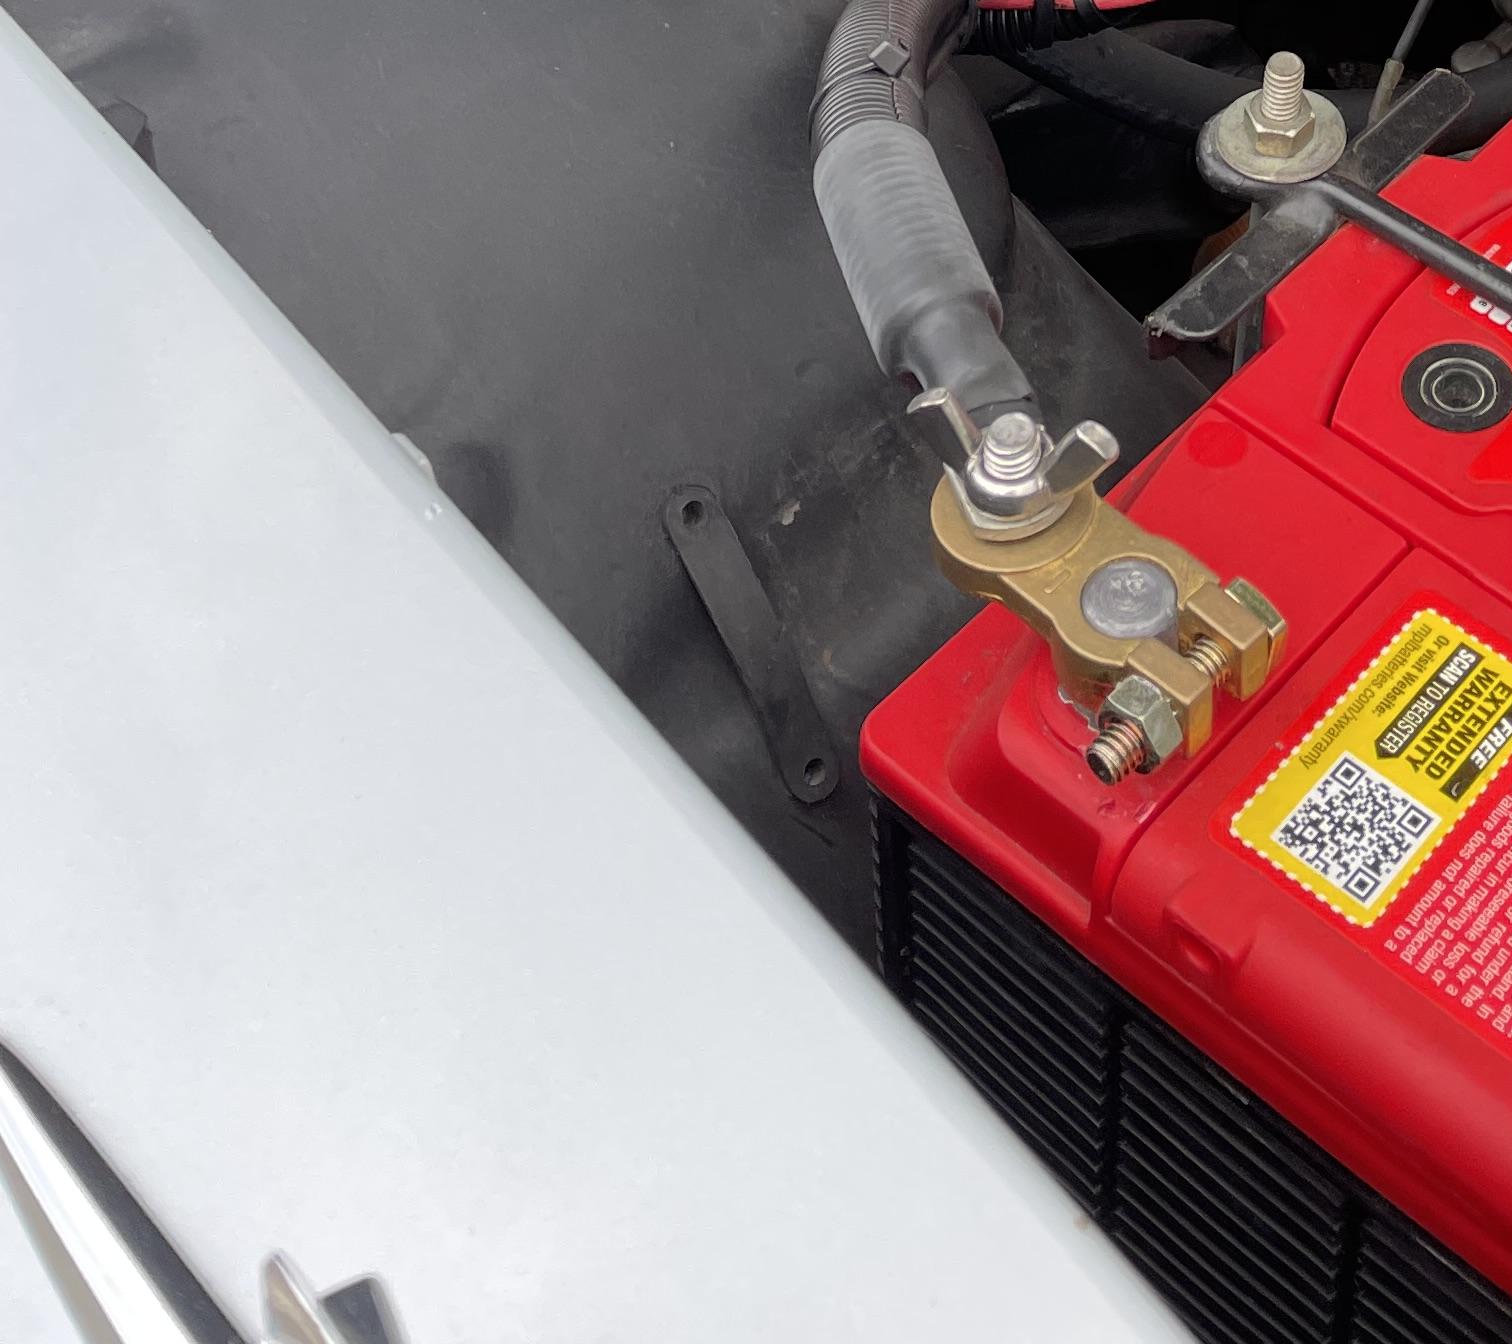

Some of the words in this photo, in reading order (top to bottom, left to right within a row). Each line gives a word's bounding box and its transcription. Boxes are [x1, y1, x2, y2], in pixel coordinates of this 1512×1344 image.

[1411, 646, 1438, 673] visit
[1429, 633, 1450, 652] Or
[1437, 646, 1477, 686] SCAN
[1294, 620, 1433, 772] mplbatteries.com/xwarranty
[1422, 677, 1450, 702] TO
[1377, 695, 1434, 755] REGISTER
[1400, 663, 1499, 774] WARRANTY
